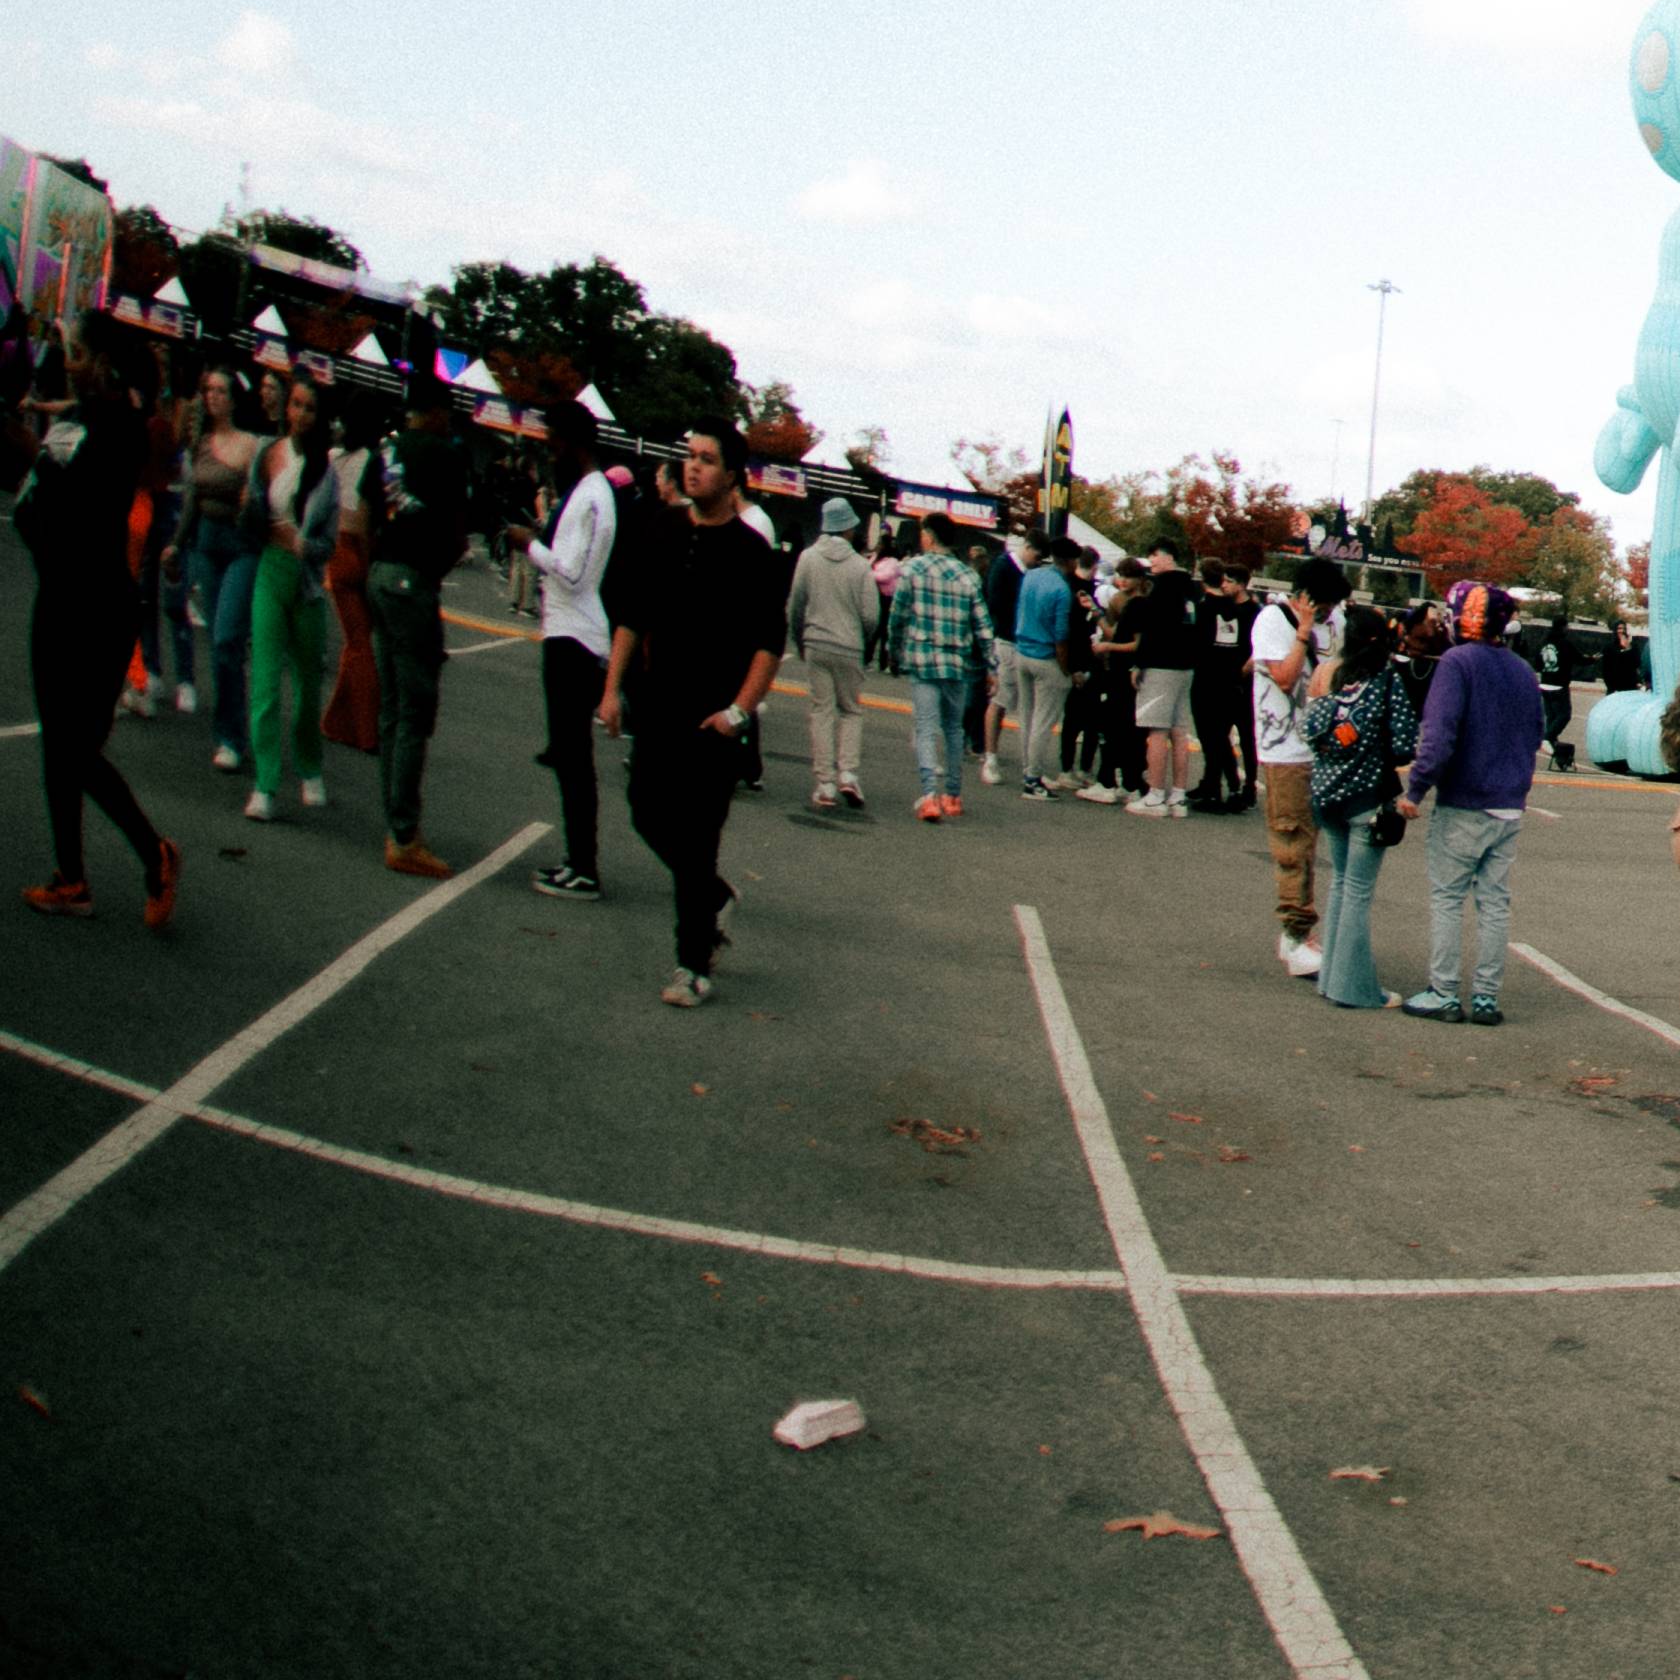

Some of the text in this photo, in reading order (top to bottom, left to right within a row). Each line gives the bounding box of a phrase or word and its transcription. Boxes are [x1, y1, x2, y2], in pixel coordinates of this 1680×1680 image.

[1049, 422, 1071, 509] ATM
[901, 491, 994, 519] CASH ONLY
[1313, 536, 1364, 560] Mets
